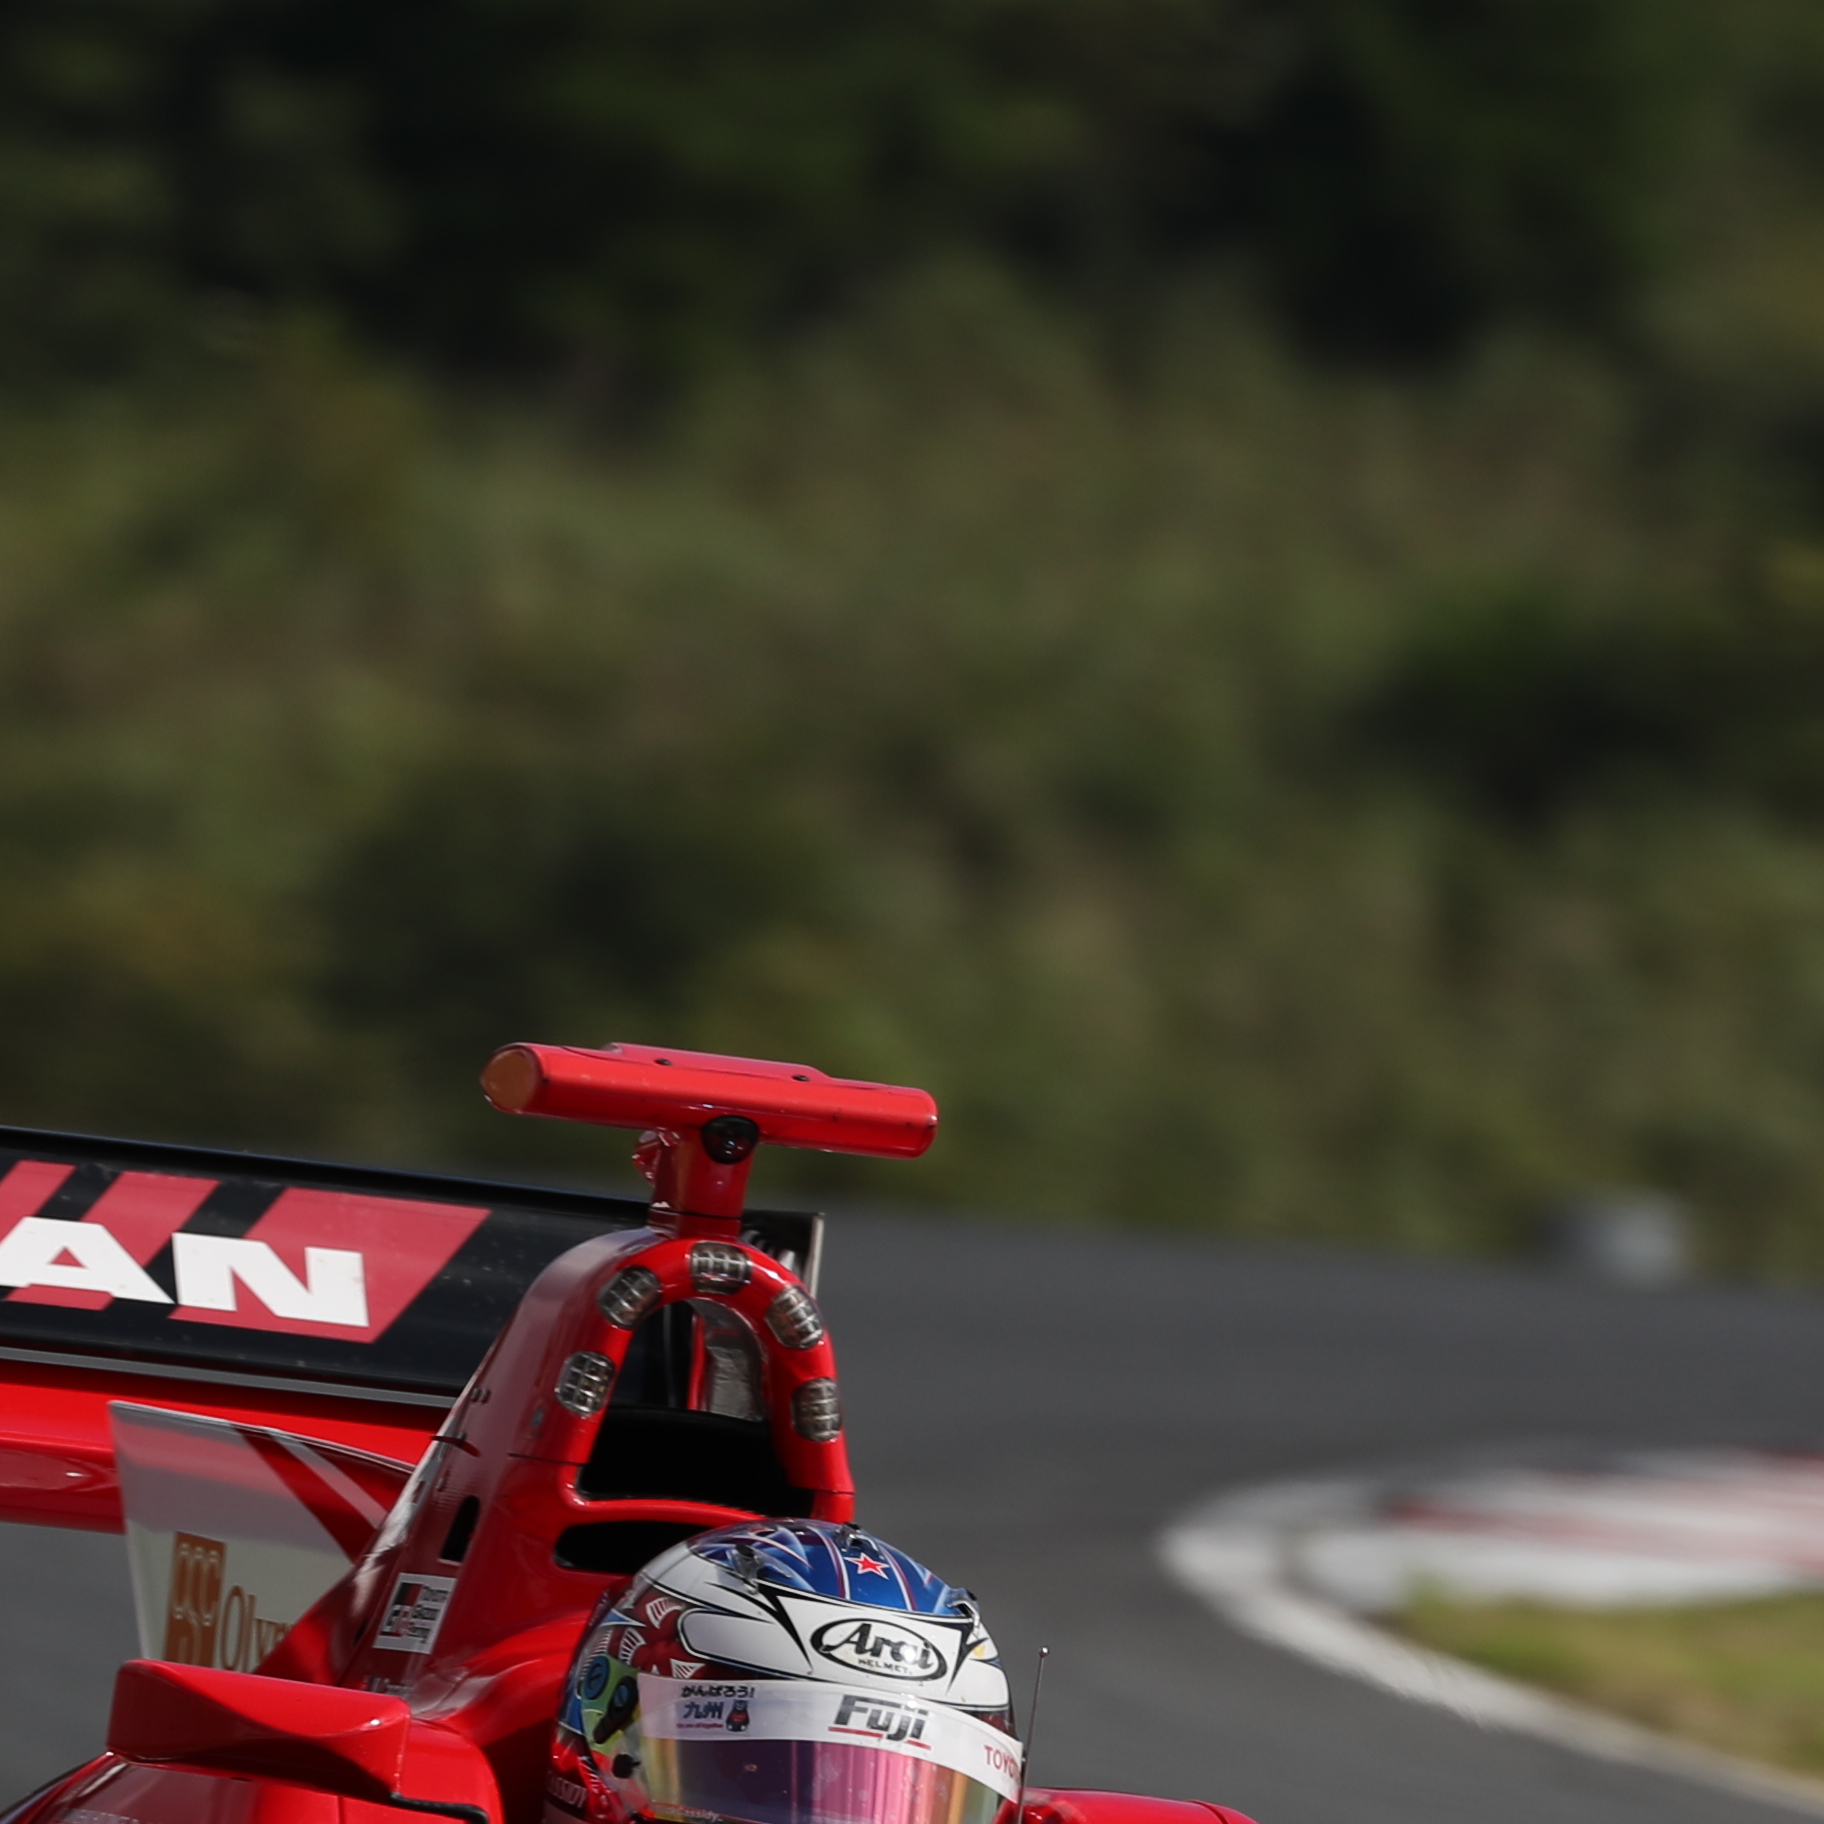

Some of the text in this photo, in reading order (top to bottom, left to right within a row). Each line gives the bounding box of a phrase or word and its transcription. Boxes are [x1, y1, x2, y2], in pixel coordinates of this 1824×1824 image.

[818, 1622, 934, 1669] Arai
[682, 1700, 725, 1720] 九州
[833, 1694, 930, 1743] Fuji
